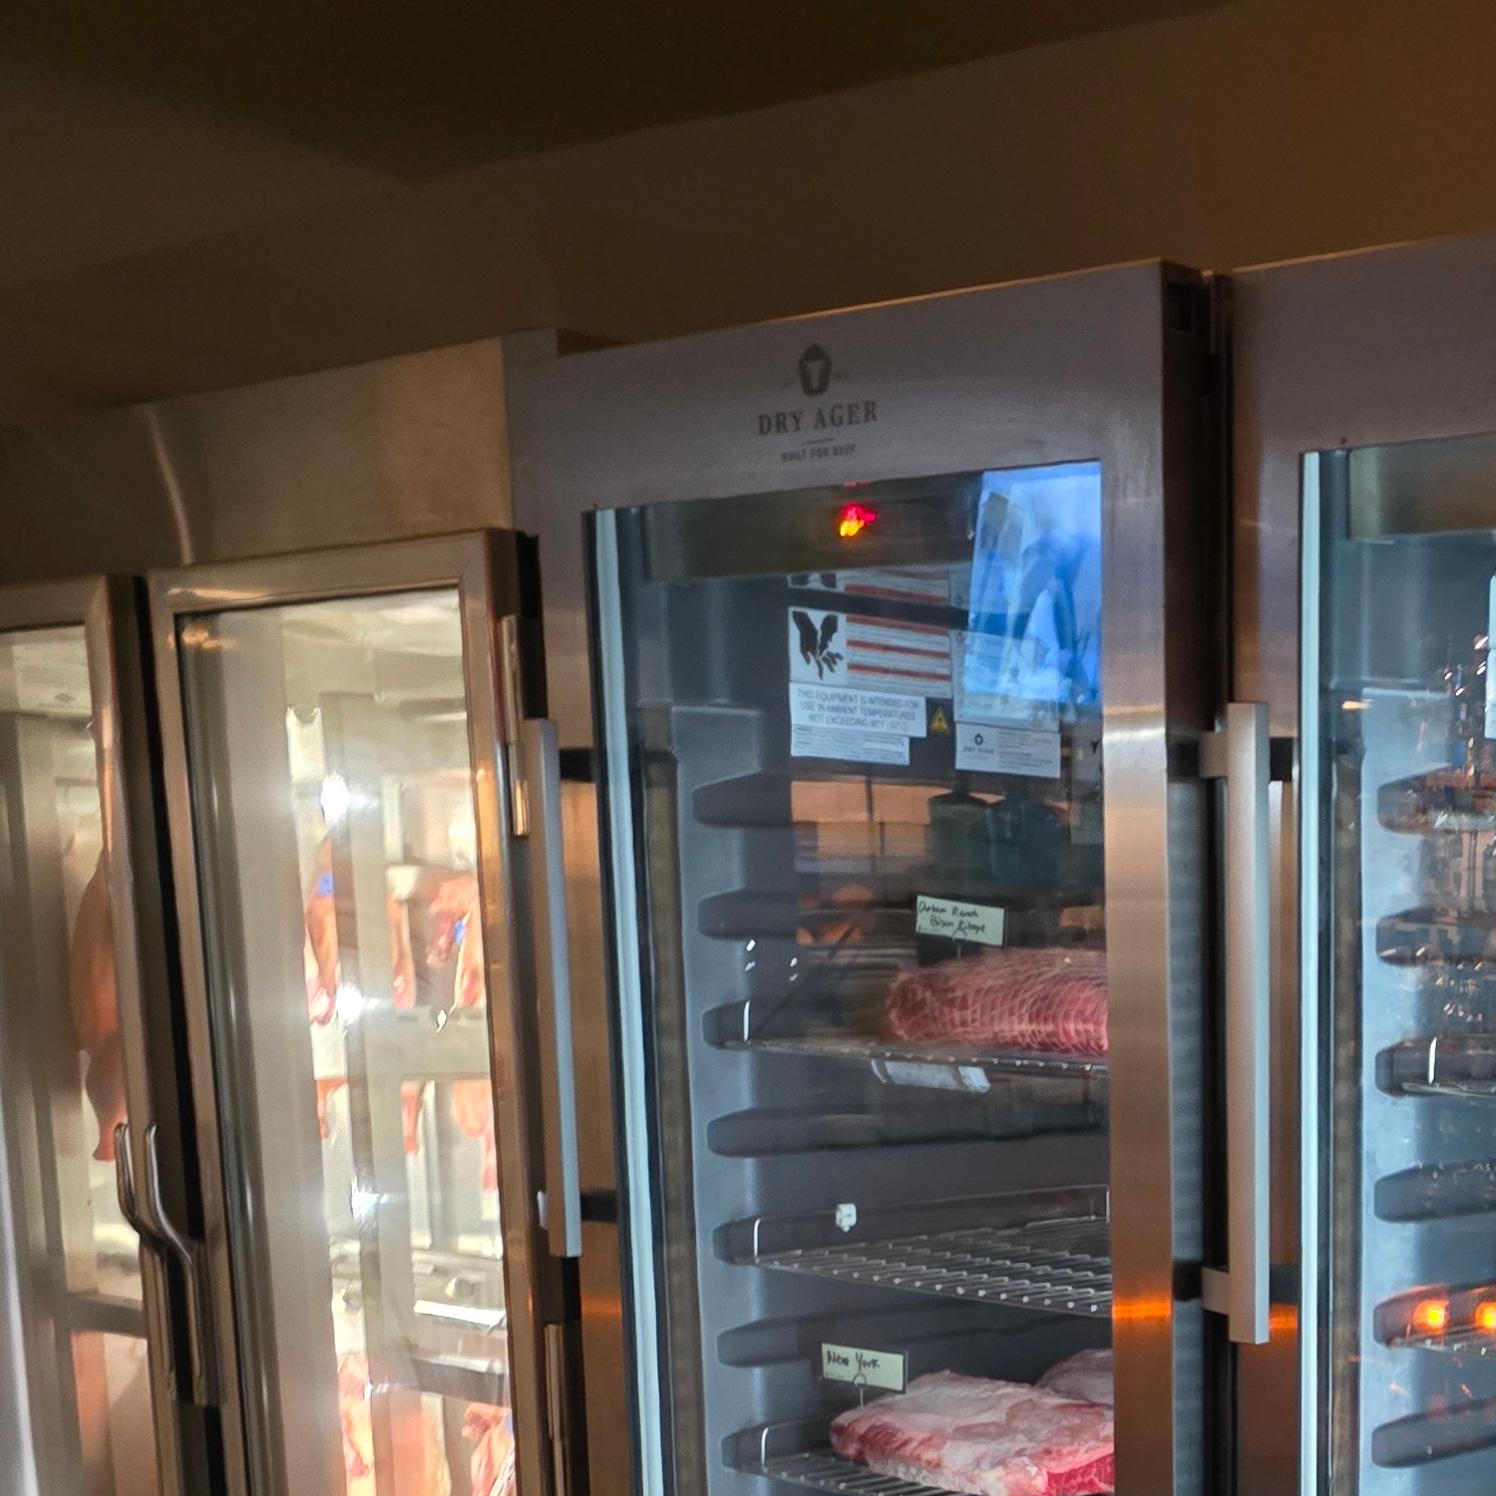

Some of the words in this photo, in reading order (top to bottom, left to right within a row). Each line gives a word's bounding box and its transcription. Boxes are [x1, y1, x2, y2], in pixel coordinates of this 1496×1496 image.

[758, 411, 802, 436] DRY
[813, 400, 878, 428] AGER
[827, 1350, 849, 1366] New
[856, 1352, 880, 1374] York
